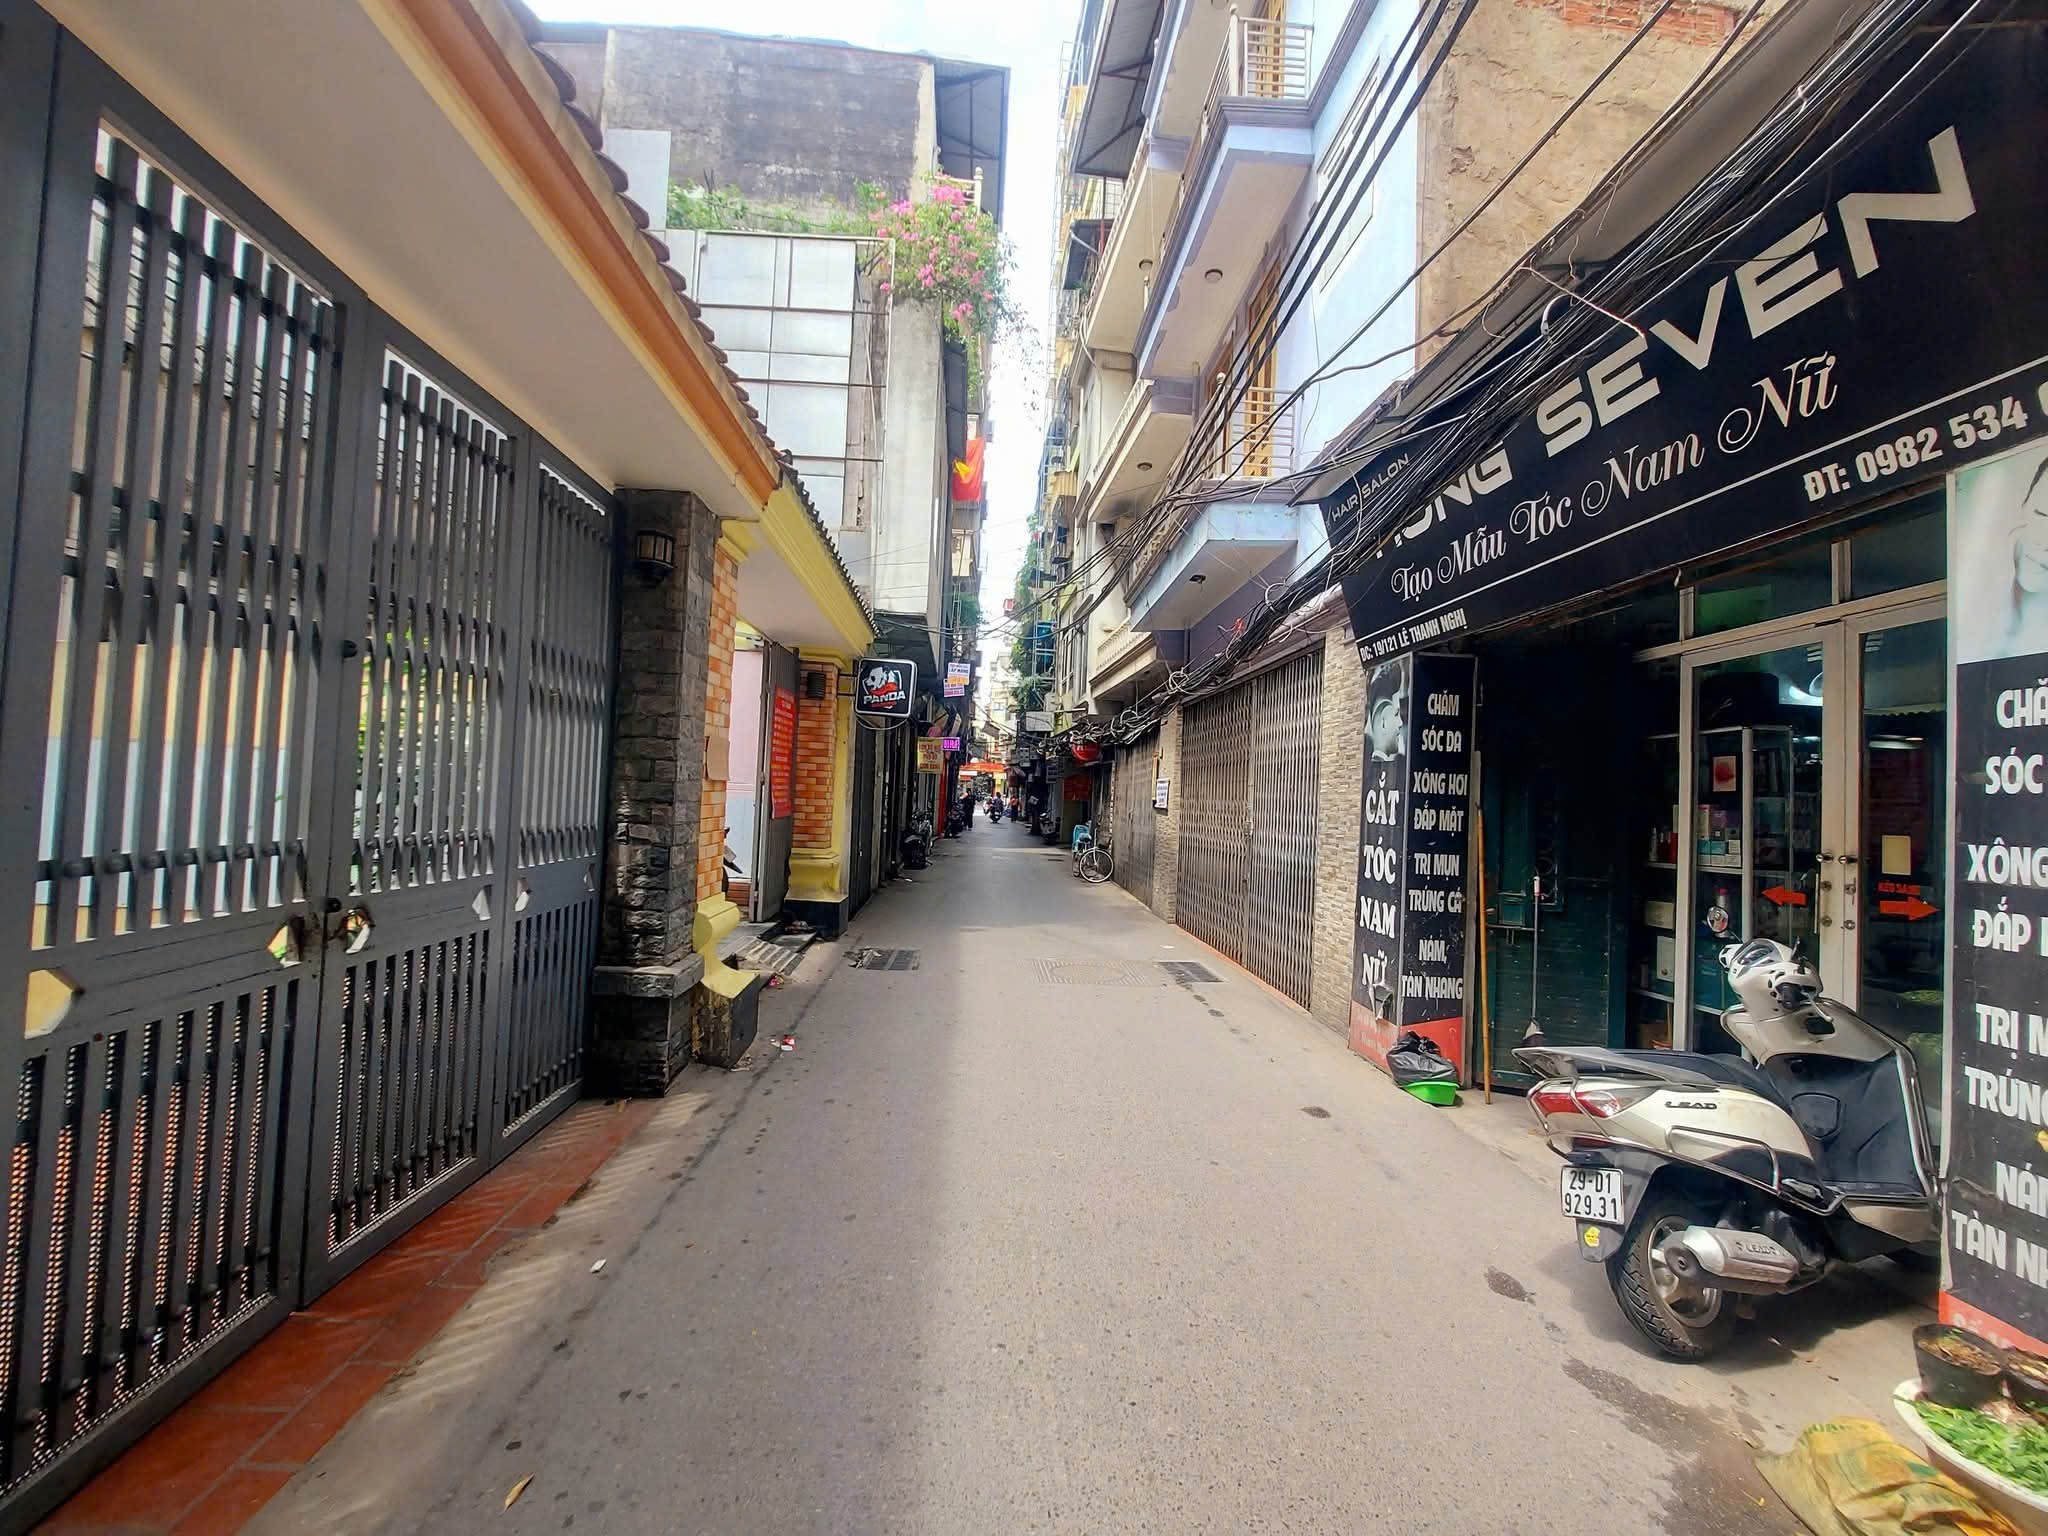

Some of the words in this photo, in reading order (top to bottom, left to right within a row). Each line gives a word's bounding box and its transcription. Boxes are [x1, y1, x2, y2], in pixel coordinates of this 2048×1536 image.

[1536, 125, 1977, 458] SEVEN
[1803, 462, 1850, 502] ĐT:
[1855, 427, 1943, 483] 0982
[1948, 396, 2029, 449] 534
[1331, 493, 1359, 522] HAIR
[1361, 453, 1410, 499] SALON
[1390, 563, 1433, 602] Tạo
[1437, 525, 1507, 584] Mẫu
[1509, 491, 1573, 545] Tóc
[1580, 433, 1705, 517] Nam
[1717, 351, 1838, 453] Nữ
[1373, 634, 1399, 657] 19/121
[1409, 618, 1441, 644] THANH
[1440, 608, 1468, 633] NGHỊ
[863, 690, 907, 705] PANDA
[1427, 689, 1460, 716] CHĂM
[1421, 724, 1444, 752] SÓC
[1446, 730, 1462, 752] DA
[1412, 768, 1446, 795] XÔNG
[1985, 747, 2043, 795] SÓC
[1365, 771, 1400, 826] CẮT
[1413, 800, 1437, 830] ĐẮP
[1438, 805, 1464, 837] MẶT
[1363, 836, 1397, 884] TÓC
[1414, 853, 1431, 881] TRỊ
[1432, 854, 1460, 881] MỤN
[1967, 836, 2048, 888] XÔNG
[1359, 895, 1397, 939] NAM
[1447, 886, 1463, 914] CÁ
[1971, 896, 2032, 953] ĐẮP
[1401, 970, 1423, 998] TÀN
[1424, 975, 1464, 1000] NHANG
[1975, 1002, 2020, 1060] TRỊ
[1663, 1100, 1718, 1110] LEAD
[1569, 1170, 1612, 1194] 29-D1
[1564, 1192, 1618, 1220] 929.31
[1951, 1209, 2007, 1271] TÀN
